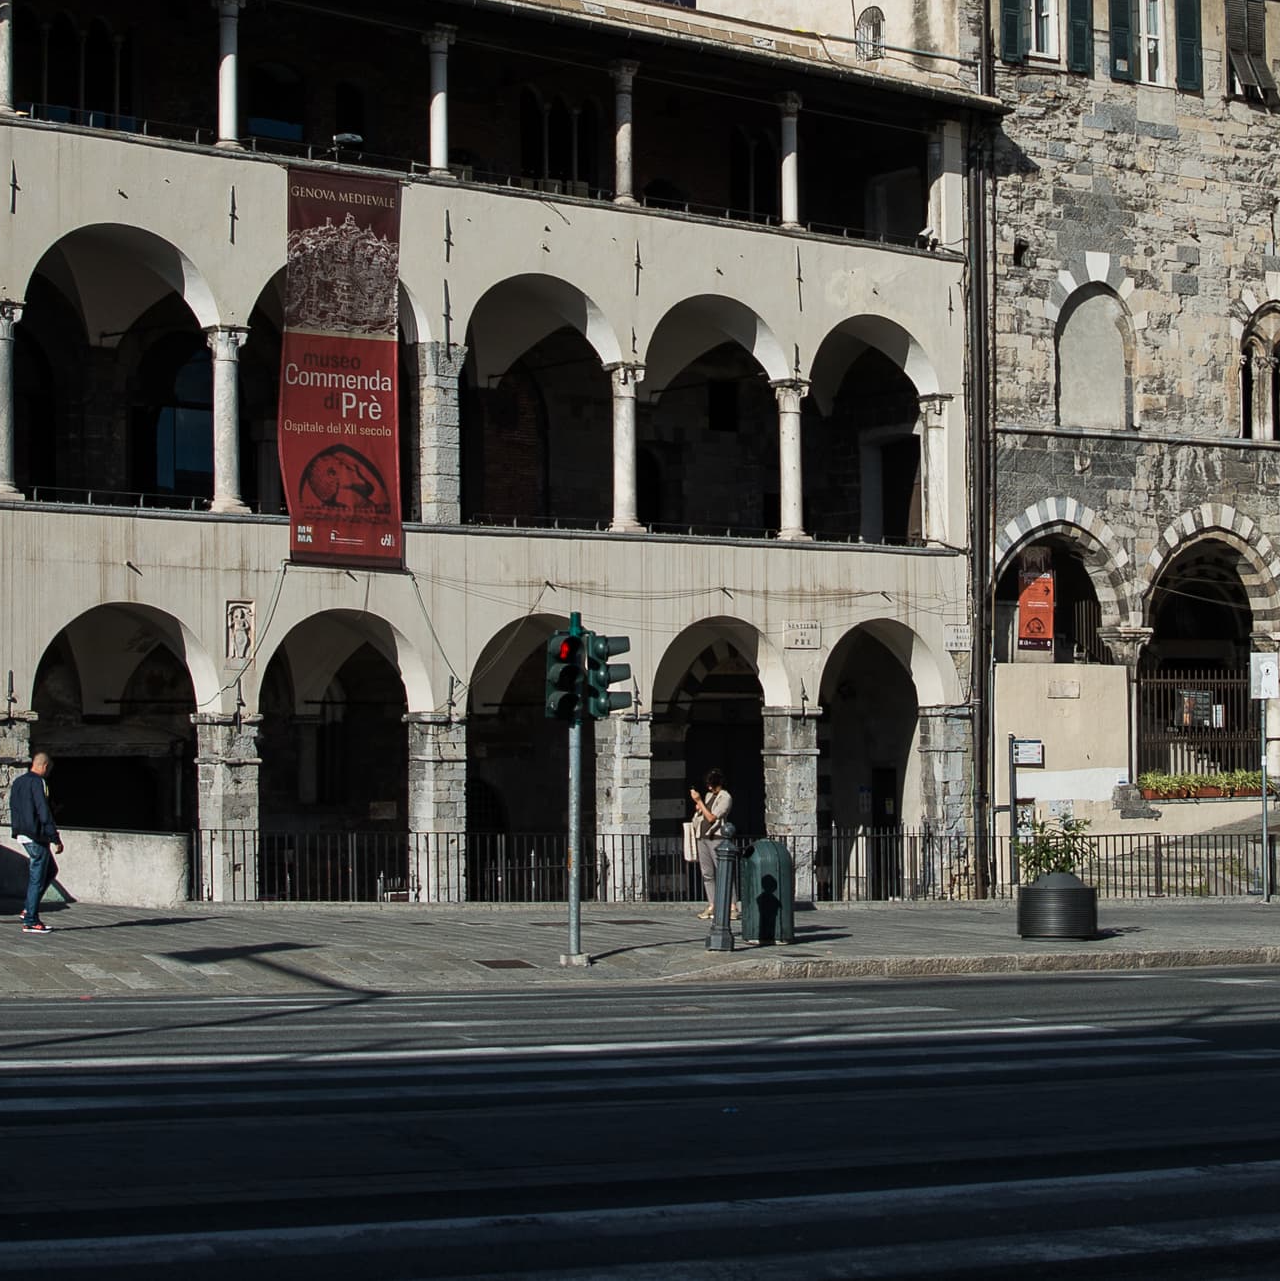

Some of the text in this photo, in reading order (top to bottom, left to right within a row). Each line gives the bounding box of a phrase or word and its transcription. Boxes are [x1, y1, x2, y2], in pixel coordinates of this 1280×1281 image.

[290, 185, 395, 208] GENOVA MEDIEVALE
[303, 351, 362, 370] museo
[285, 363, 392, 391] Commenda
[323, 391, 382, 420] di Prè
[284, 419, 392, 437] Ospitale del XII secolo
